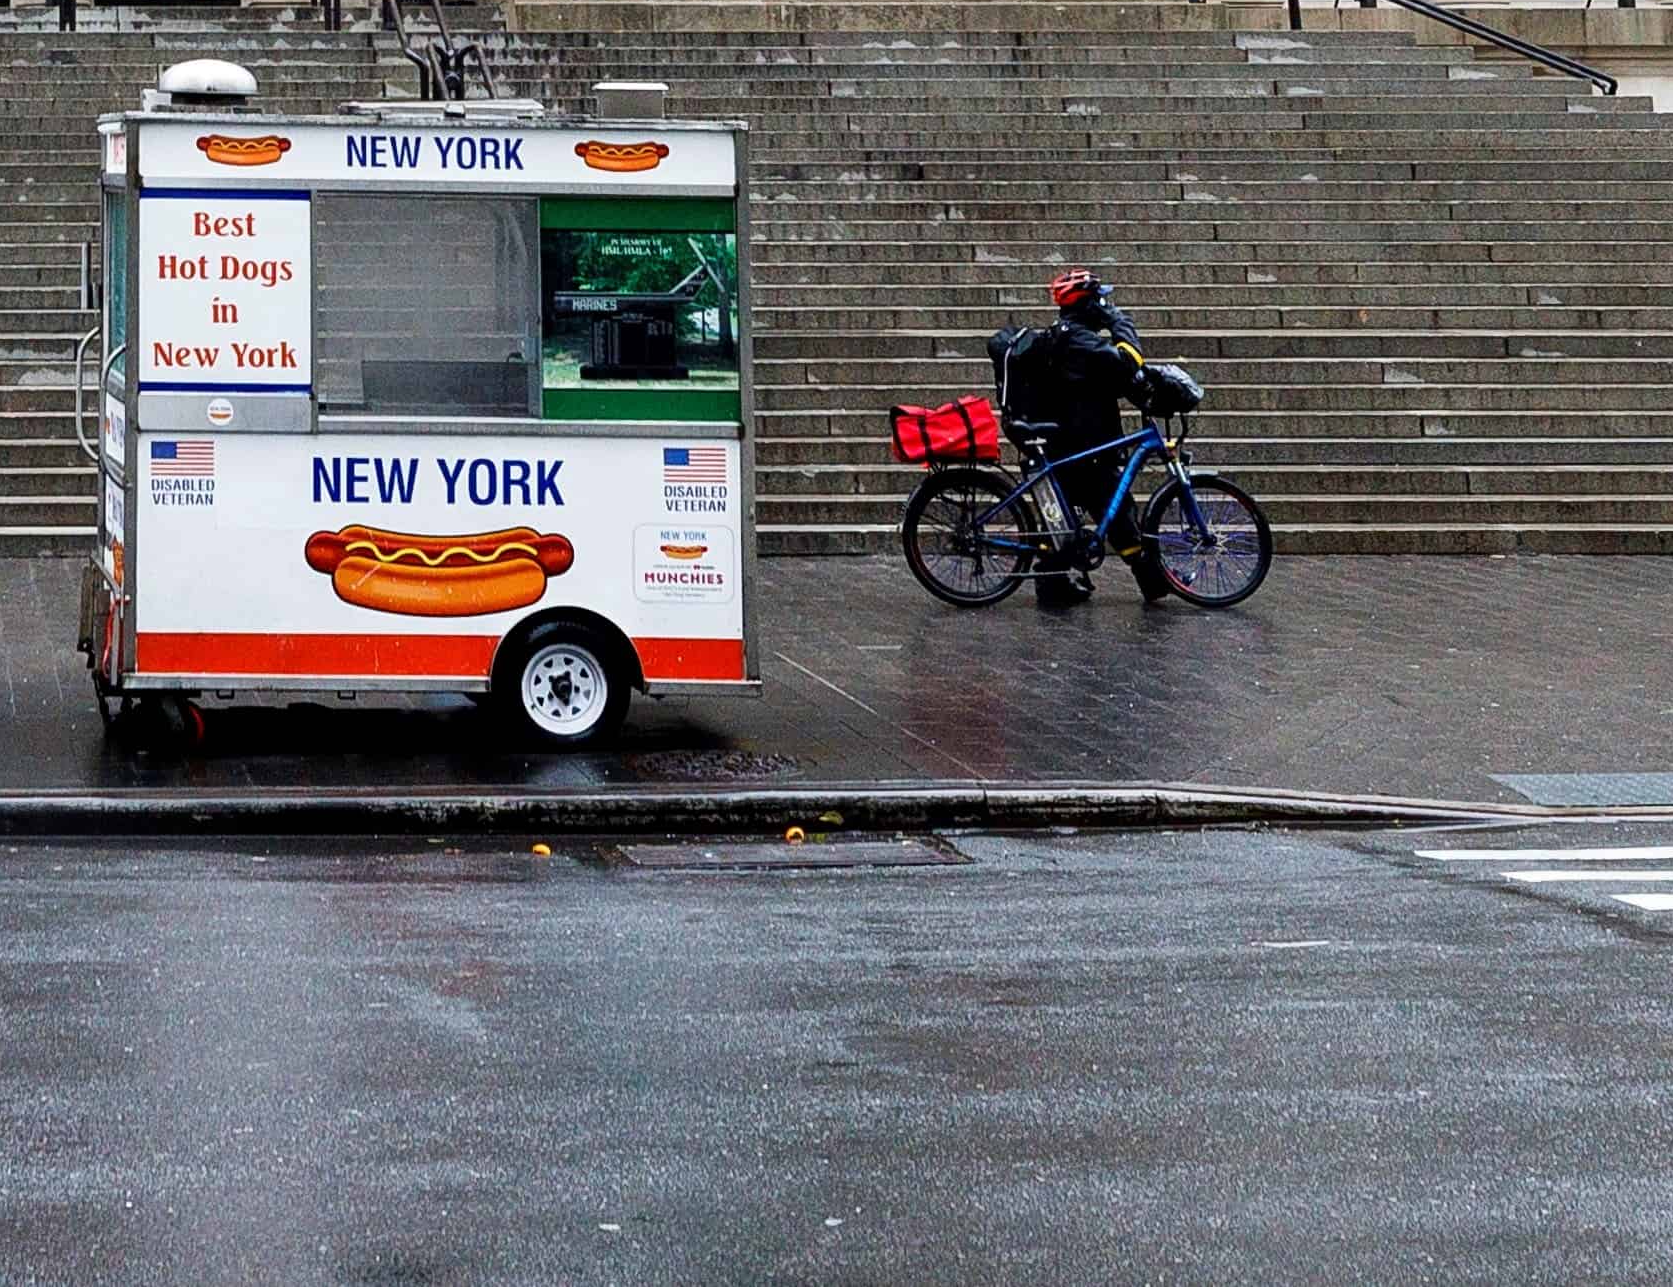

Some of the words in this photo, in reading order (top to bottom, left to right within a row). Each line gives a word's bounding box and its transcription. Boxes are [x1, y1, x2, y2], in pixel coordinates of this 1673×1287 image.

[346, 135, 421, 168] NEW
[435, 136, 524, 171] YORK
[194, 212, 256, 237] Best
[158, 255, 209, 281] Hot
[220, 255, 293, 287] Dogs
[212, 297, 239, 324] in
[573, 298, 617, 311] MARINES
[153, 342, 219, 367] New
[231, 341, 297, 368] York
[151, 479, 214, 491] DISABLED
[312, 457, 419, 505] NEW
[437, 458, 565, 506] YORK
[153, 493, 213, 505] VETERAN
[664, 486, 727, 499] DISABLED
[665, 500, 726, 512] VETERAN
[661, 531, 681, 541] NEW
[683, 532, 707, 541] YORK
[644, 572, 723, 585] MUNCHIES
